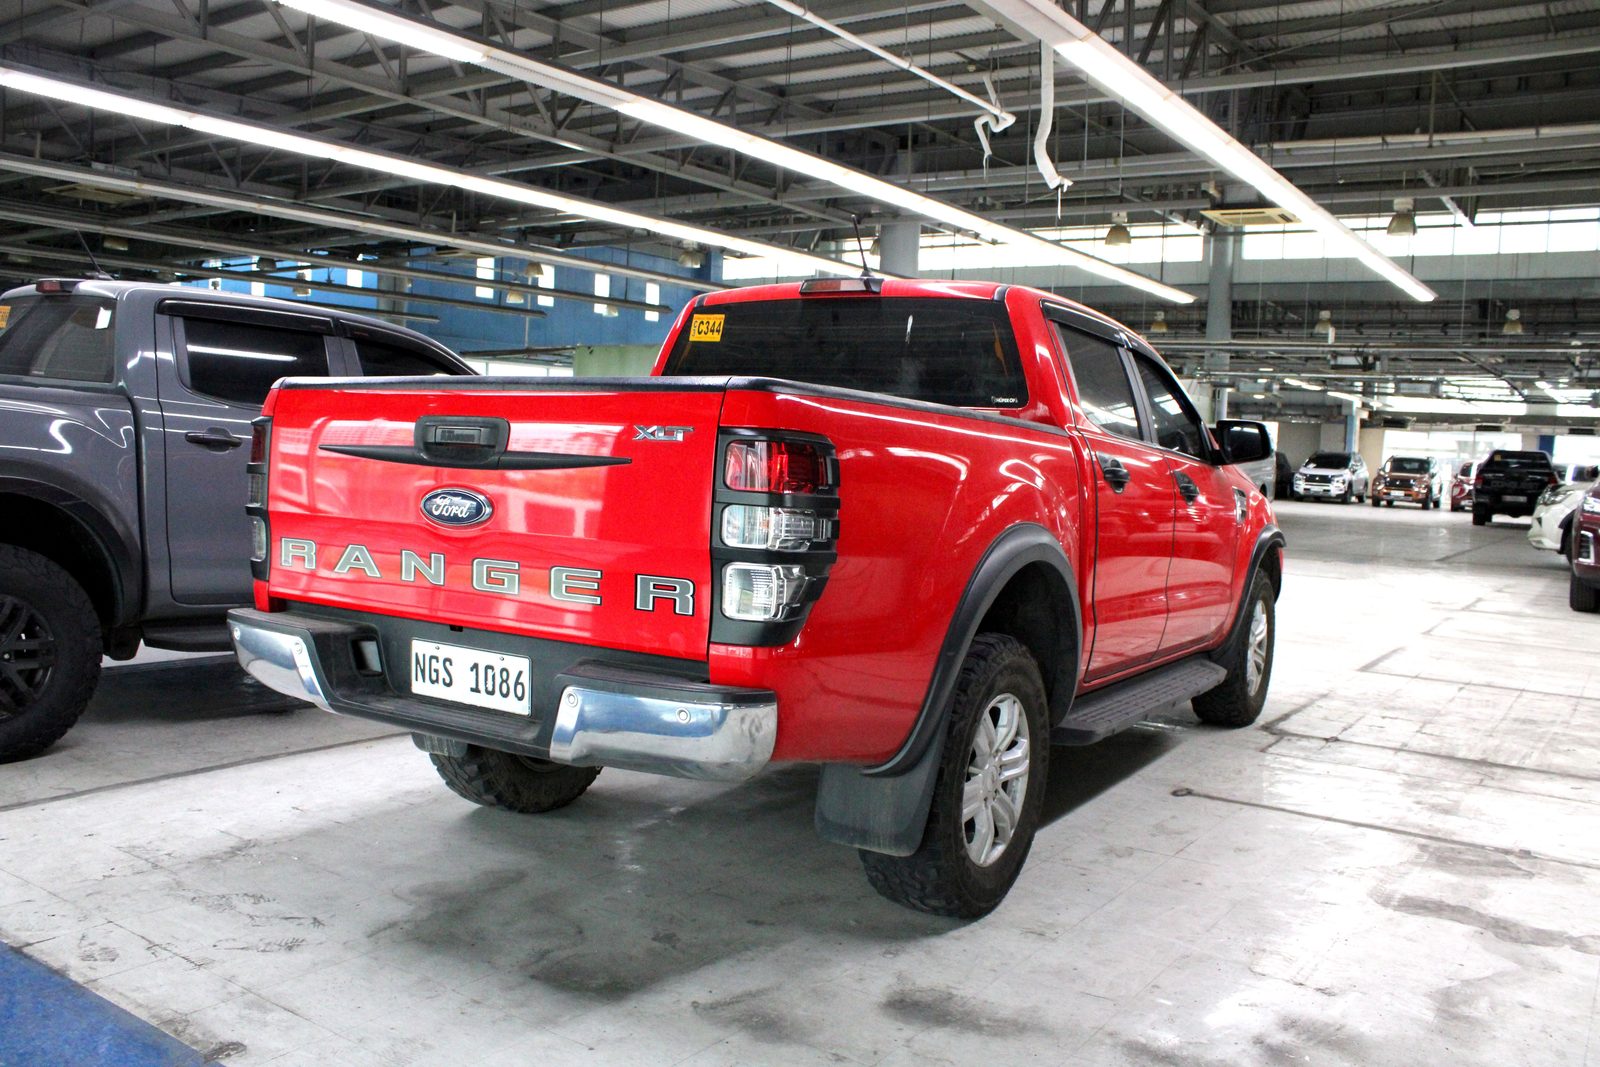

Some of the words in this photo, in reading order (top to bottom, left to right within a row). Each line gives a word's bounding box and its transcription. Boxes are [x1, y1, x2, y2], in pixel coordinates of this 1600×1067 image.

[698, 321, 721, 335] C344
[632, 424, 695, 442] XLT
[431, 494, 471, 520] Ford
[280, 537, 696, 617] RANGER
[414, 652, 454, 688] NGS
[469, 662, 526, 702] 1086
